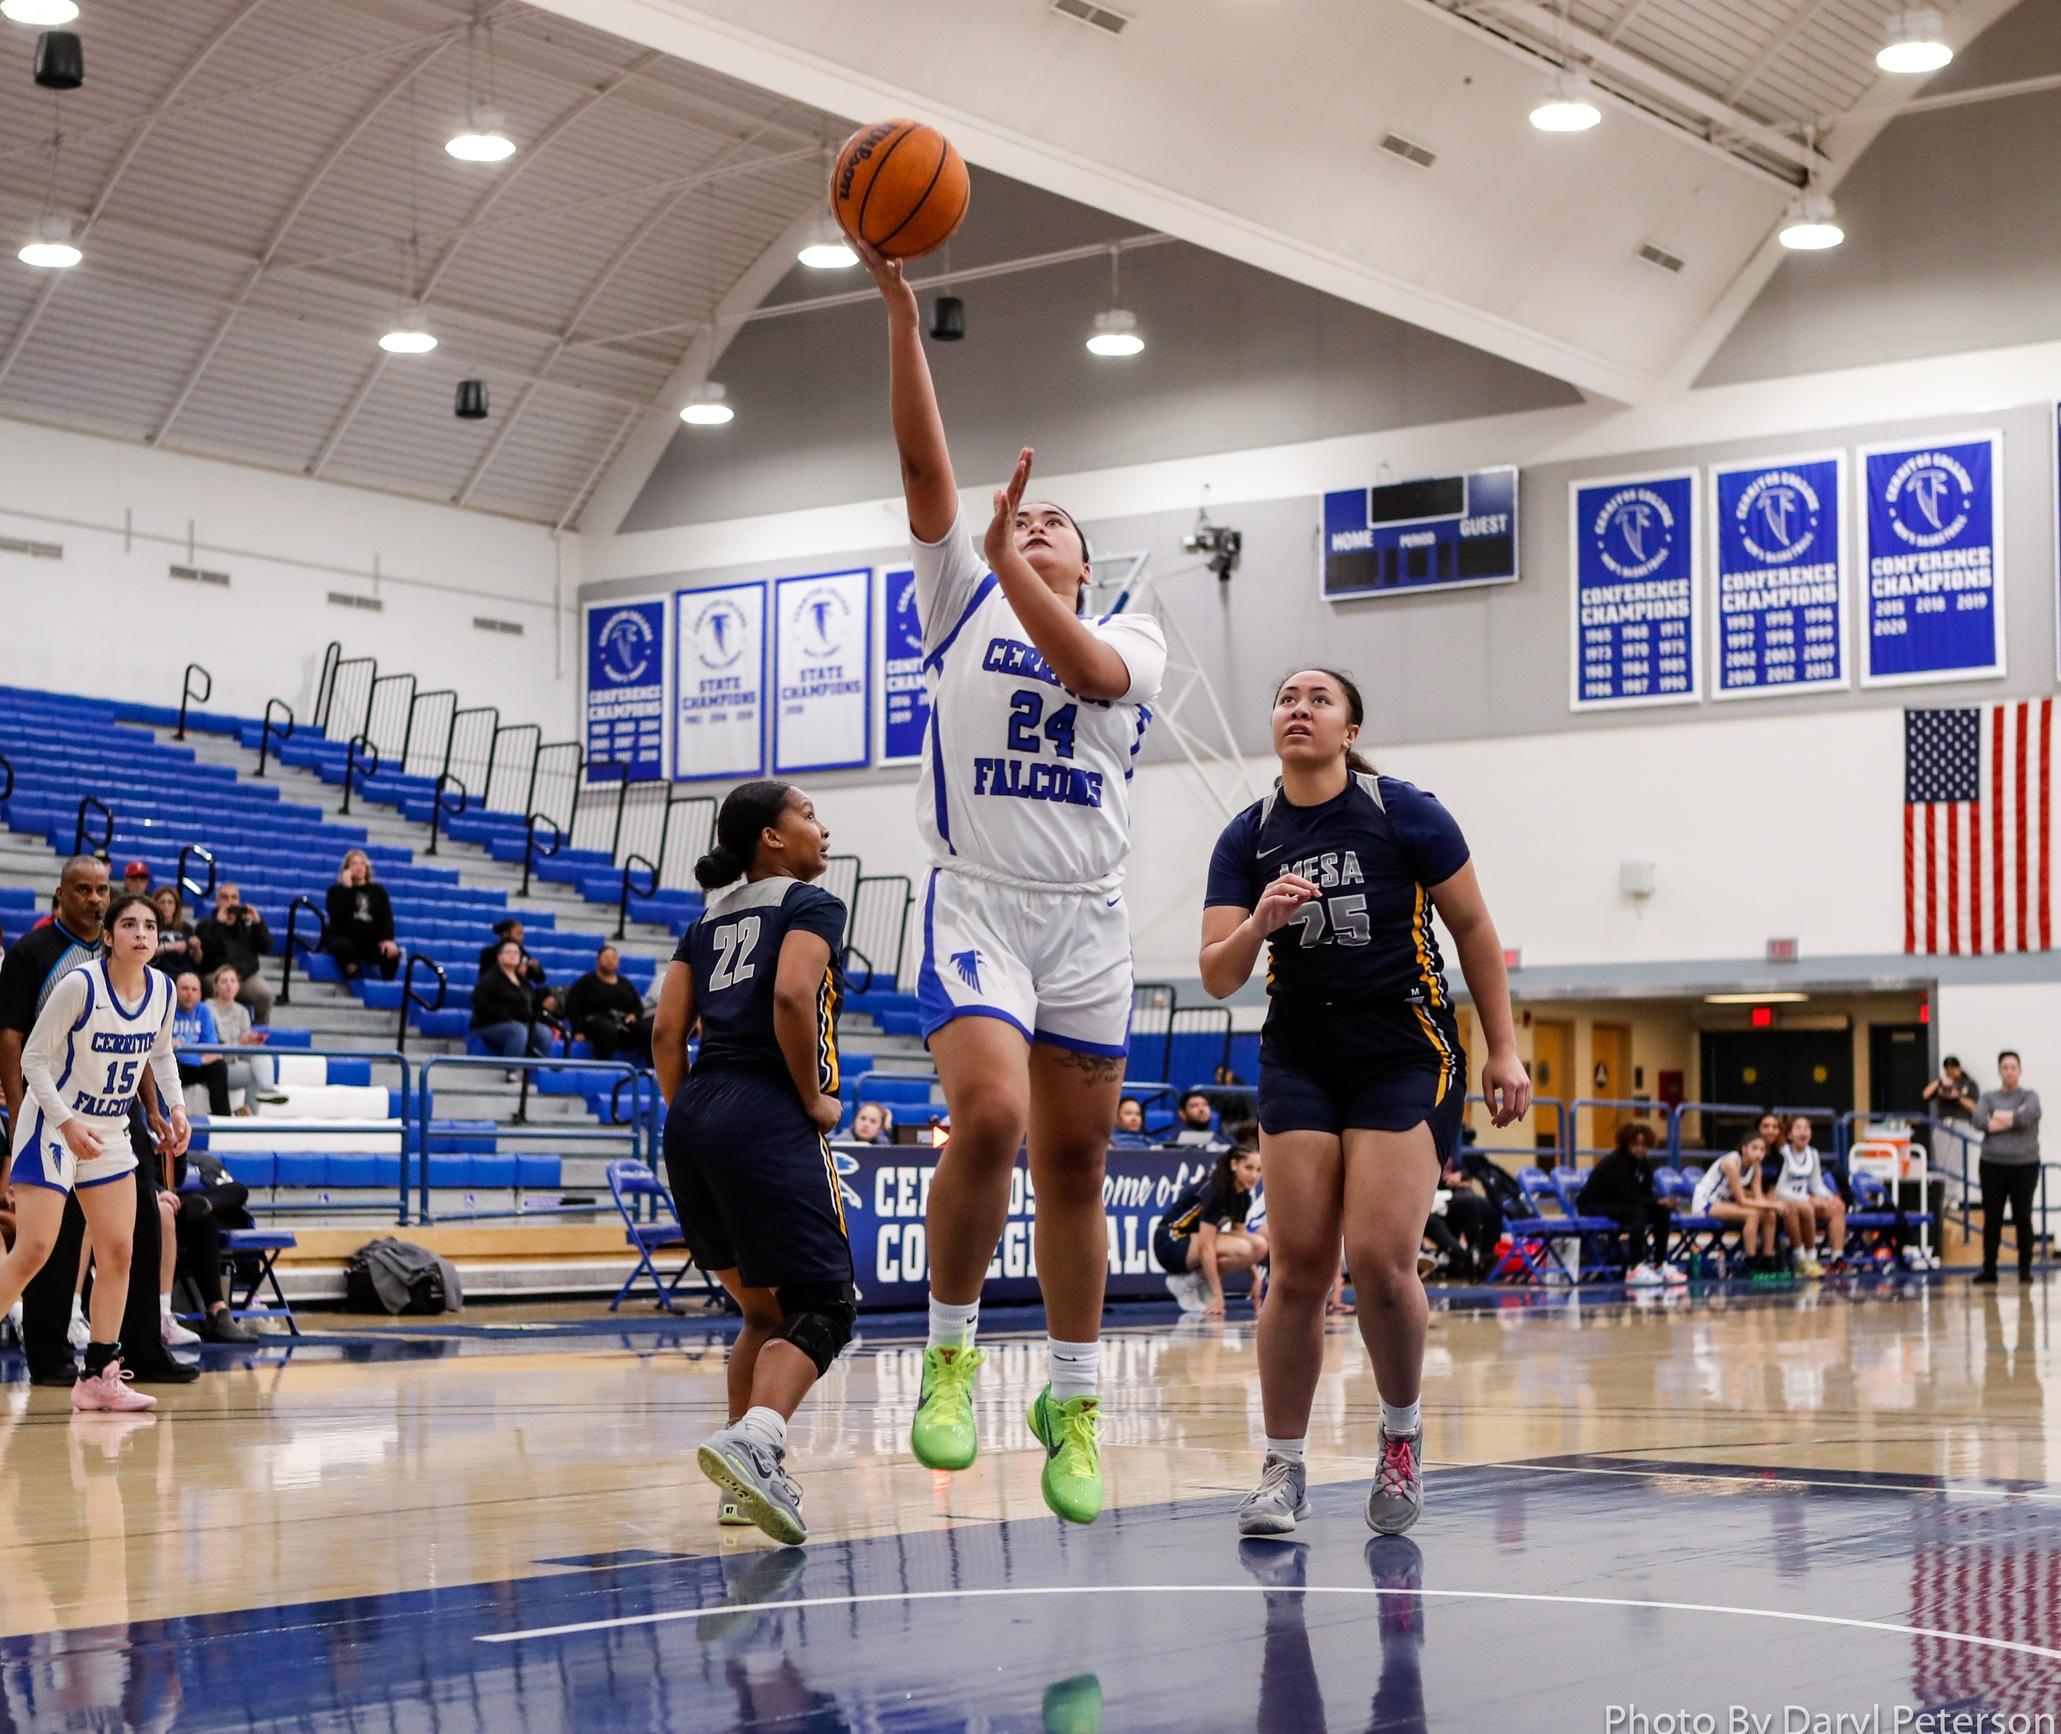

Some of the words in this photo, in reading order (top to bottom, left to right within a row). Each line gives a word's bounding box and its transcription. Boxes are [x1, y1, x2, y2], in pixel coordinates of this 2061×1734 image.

[1460, 514, 1507, 536] GUEST
[1332, 530, 1374, 551] HOME
[1400, 531, 1436, 548] PERIOD
[1871, 546, 1991, 577] CONFERENCE
[1722, 562, 1837, 592] CONFERENCE
[1871, 567, 1992, 598] CHAMPIONS
[1581, 579, 1689, 606] CONFERENCE
[1722, 583, 1837, 613] CHAMPIONS
[1582, 599, 1690, 626] CHAMPIONS
[700, 677, 741, 693] STATE
[800, 666, 842, 682] STATE
[683, 691, 755, 710] CHAMPIONS
[783, 680, 860, 700] CHAMPIONS
[1007, 689, 1078, 758] 24
[1288, 893, 1371, 948] 25
[709, 916, 761, 992] 22
[103, 1061, 138, 1094] 15
[1101, 1175, 1155, 1208] ome
[1156, 1161, 1188, 1208] of
